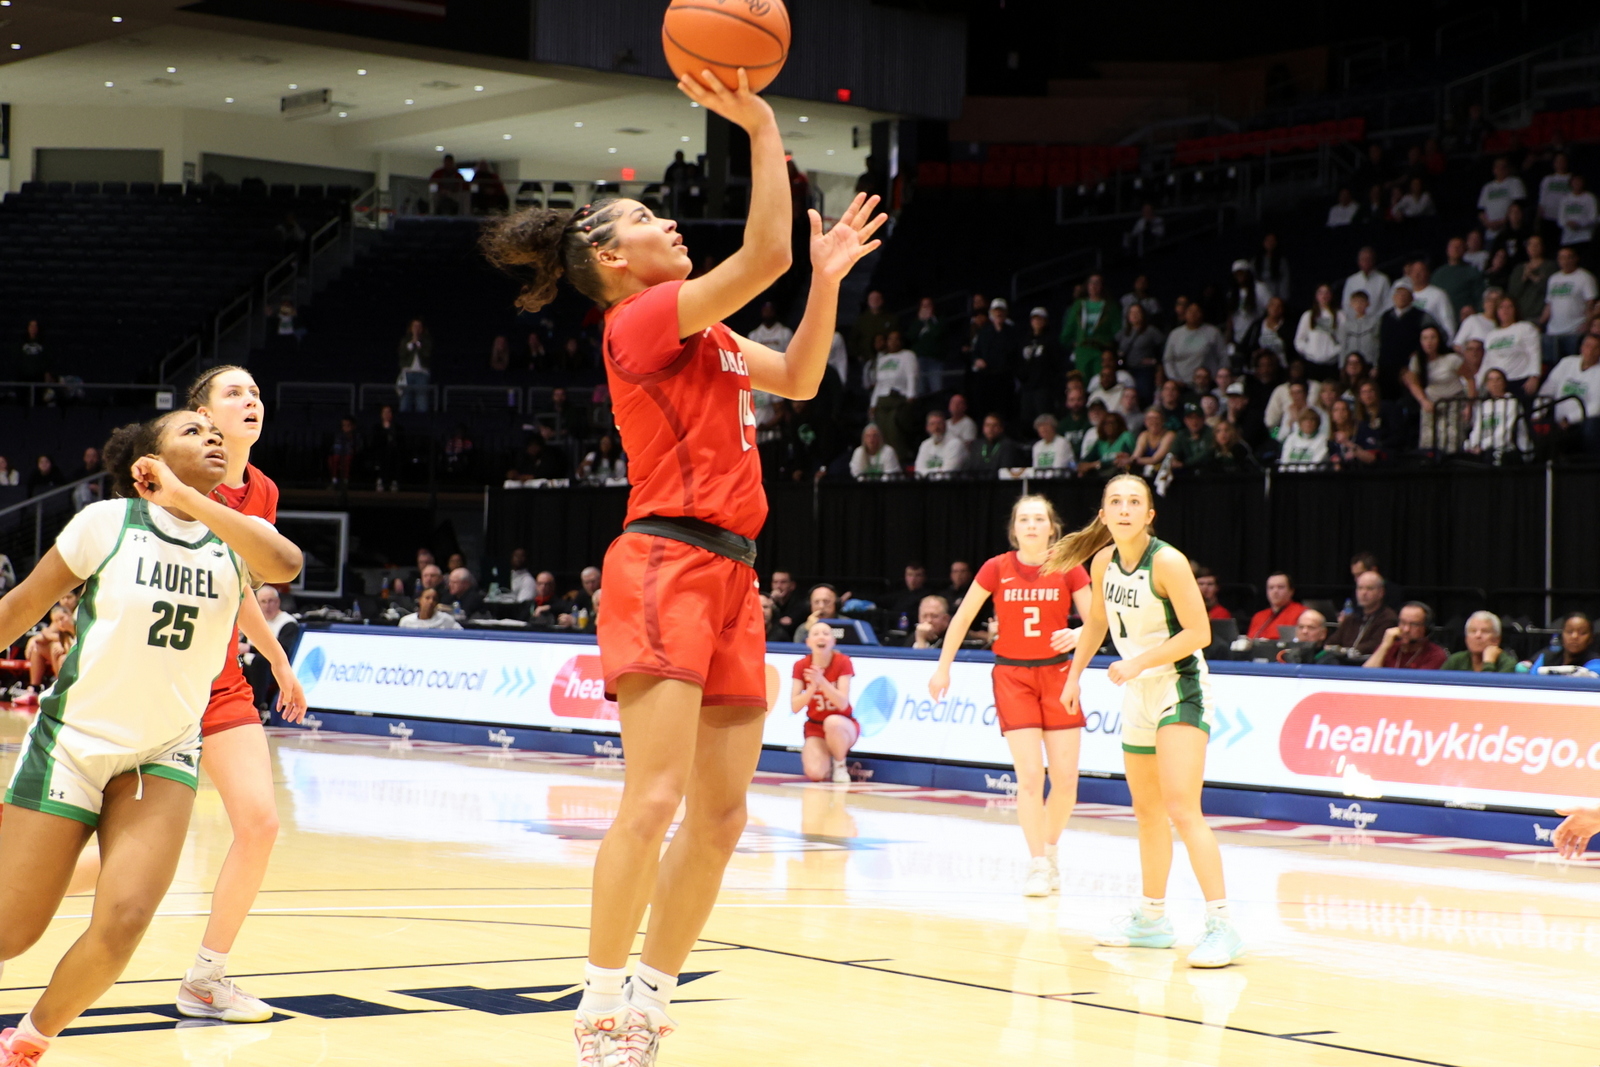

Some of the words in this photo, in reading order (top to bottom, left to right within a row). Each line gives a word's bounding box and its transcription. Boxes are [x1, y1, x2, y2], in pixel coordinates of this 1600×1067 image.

[135, 556, 219, 599] LAUREL
[1003, 588, 1060, 602] BELLEVUE
[147, 600, 200, 651] 25
[1022, 606, 1042, 638] 2
[1115, 610, 1128, 639] 1
[324, 660, 373, 684] health
[375, 664, 425, 687] action
[427, 668, 489, 691] council
[899, 693, 977, 725] health
[1305, 713, 1600, 775] healthykidsgo.c
